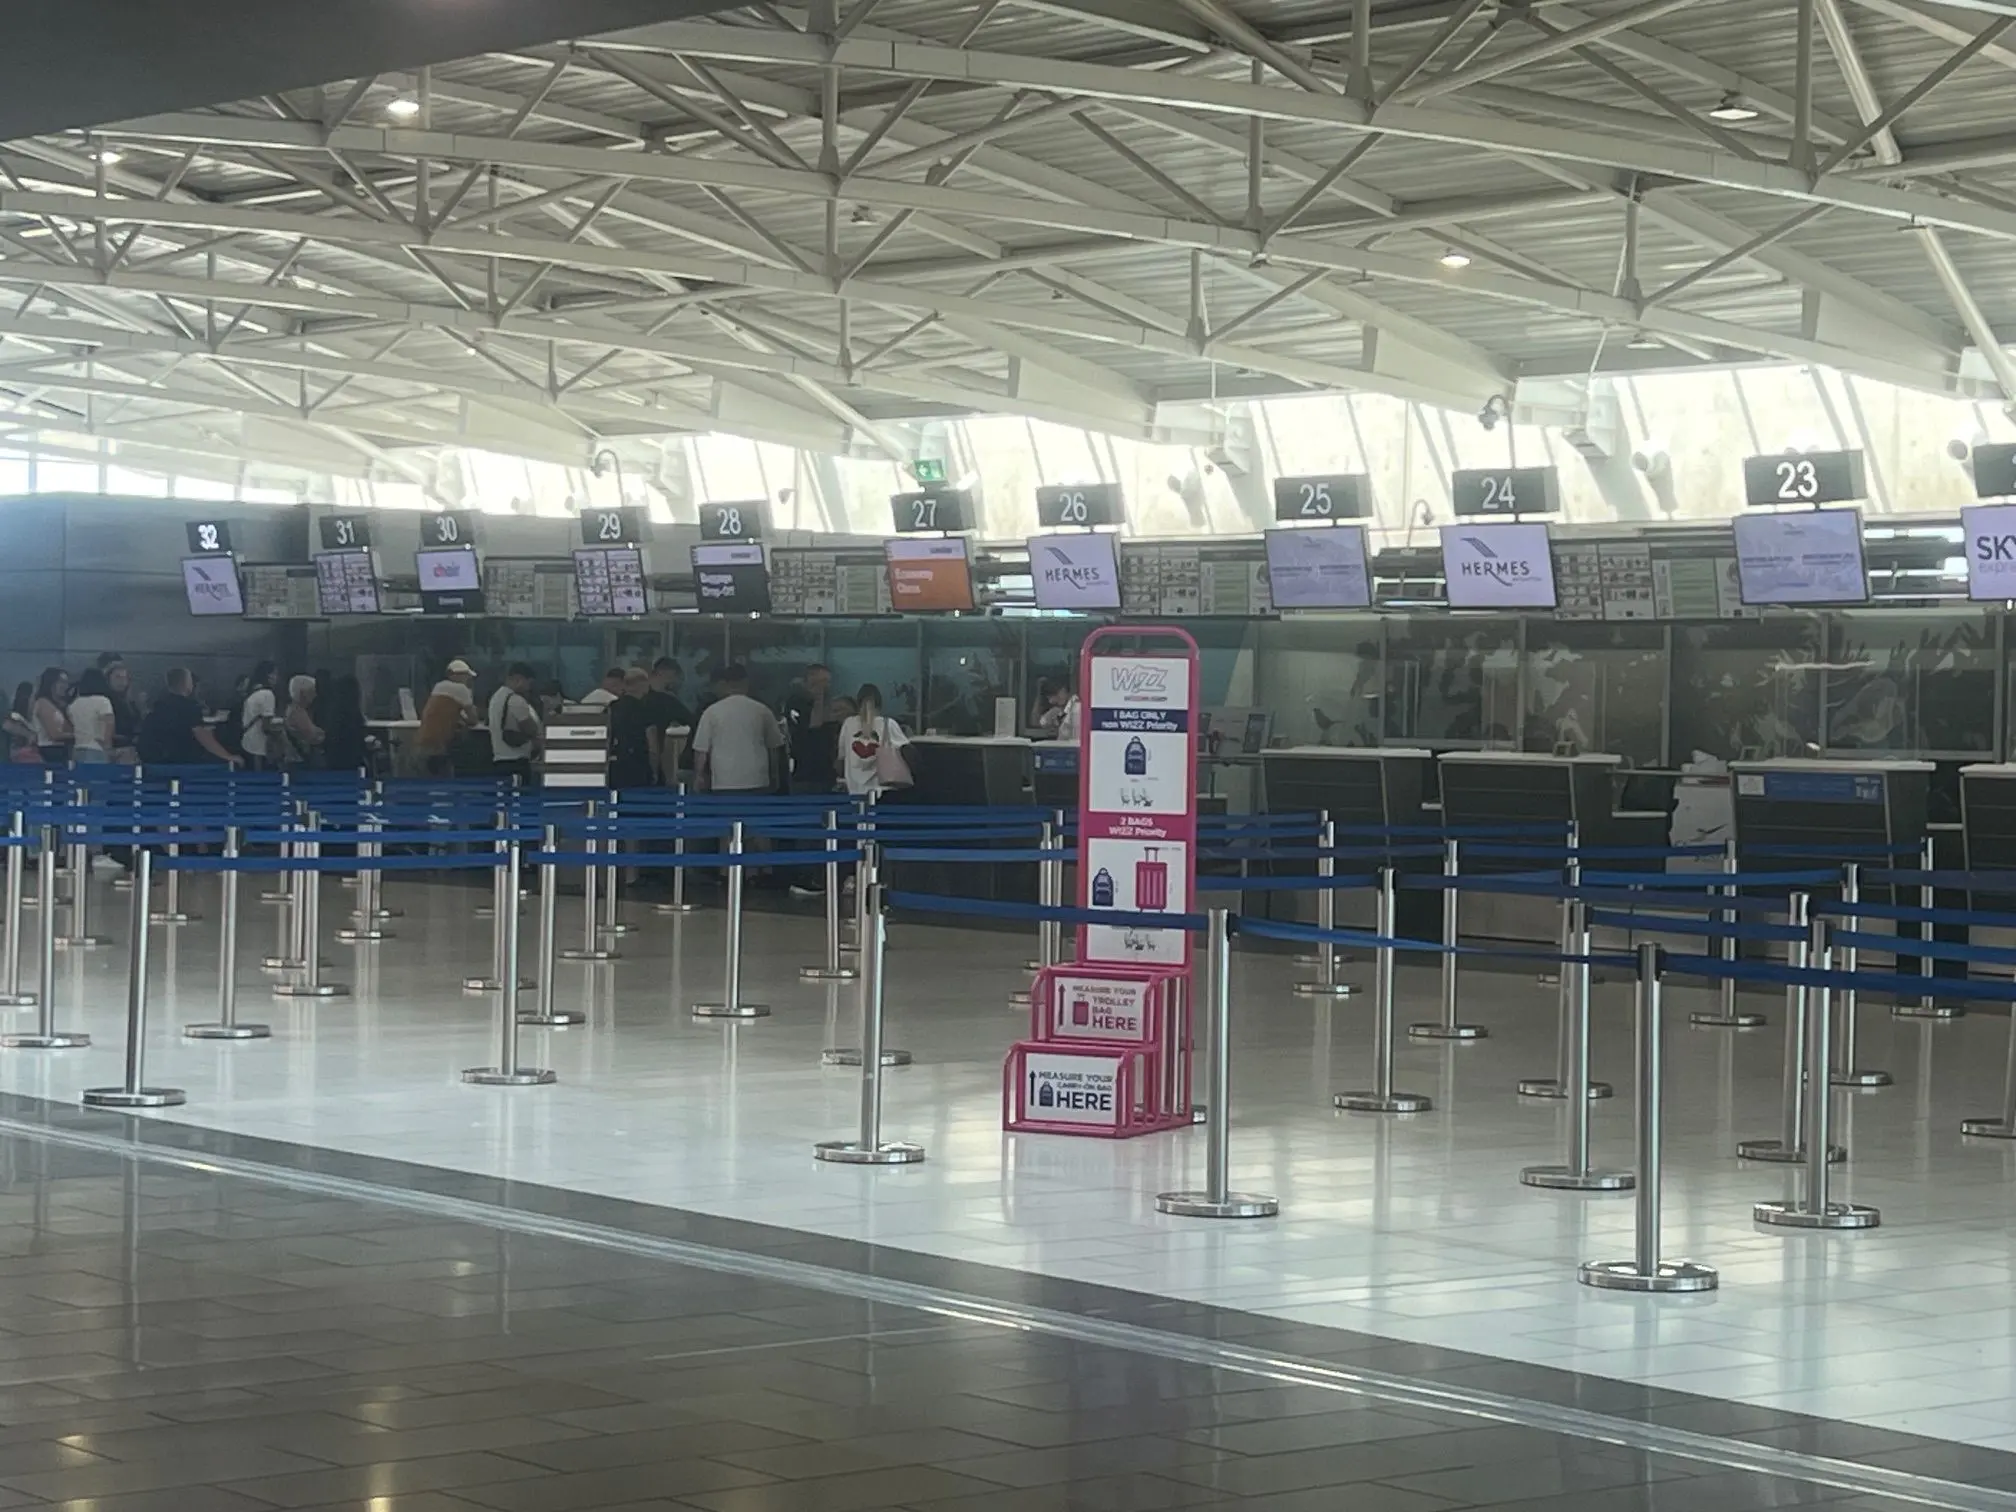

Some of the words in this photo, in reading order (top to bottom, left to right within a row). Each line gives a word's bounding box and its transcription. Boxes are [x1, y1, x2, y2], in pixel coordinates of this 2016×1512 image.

[1776, 460, 1818, 499] 23
[1300, 483, 1332, 515] 25
[1481, 476, 1516, 509] 24
[912, 499, 937, 528] 27
[1059, 492, 1088, 522] 26
[336, 520, 355, 545] 31
[435, 516, 458, 542] 30
[598, 512, 622, 540] 29
[717, 508, 742, 535] 28
[197, 524, 220, 551] 32
[1045, 566, 1100, 588] HERMES
[1461, 561, 1530, 584] HERMES
[1119, 711, 1139, 719] BAG
[1140, 711, 1167, 720] ONLY
[1120, 720, 1146, 730] WIZZ
[1146, 721, 1178, 732] Priority
[1073, 985, 1112, 995] MEASURE
[1092, 995, 1135, 1007] TROLLEY
[1092, 1006, 1112, 1015] BAG
[1092, 1015, 1137, 1031] HERE
[1039, 1071, 1083, 1082] MEASURE
[1086, 1074, 1113, 1083] YOUR
[1056, 1090, 1112, 1111] HERE
